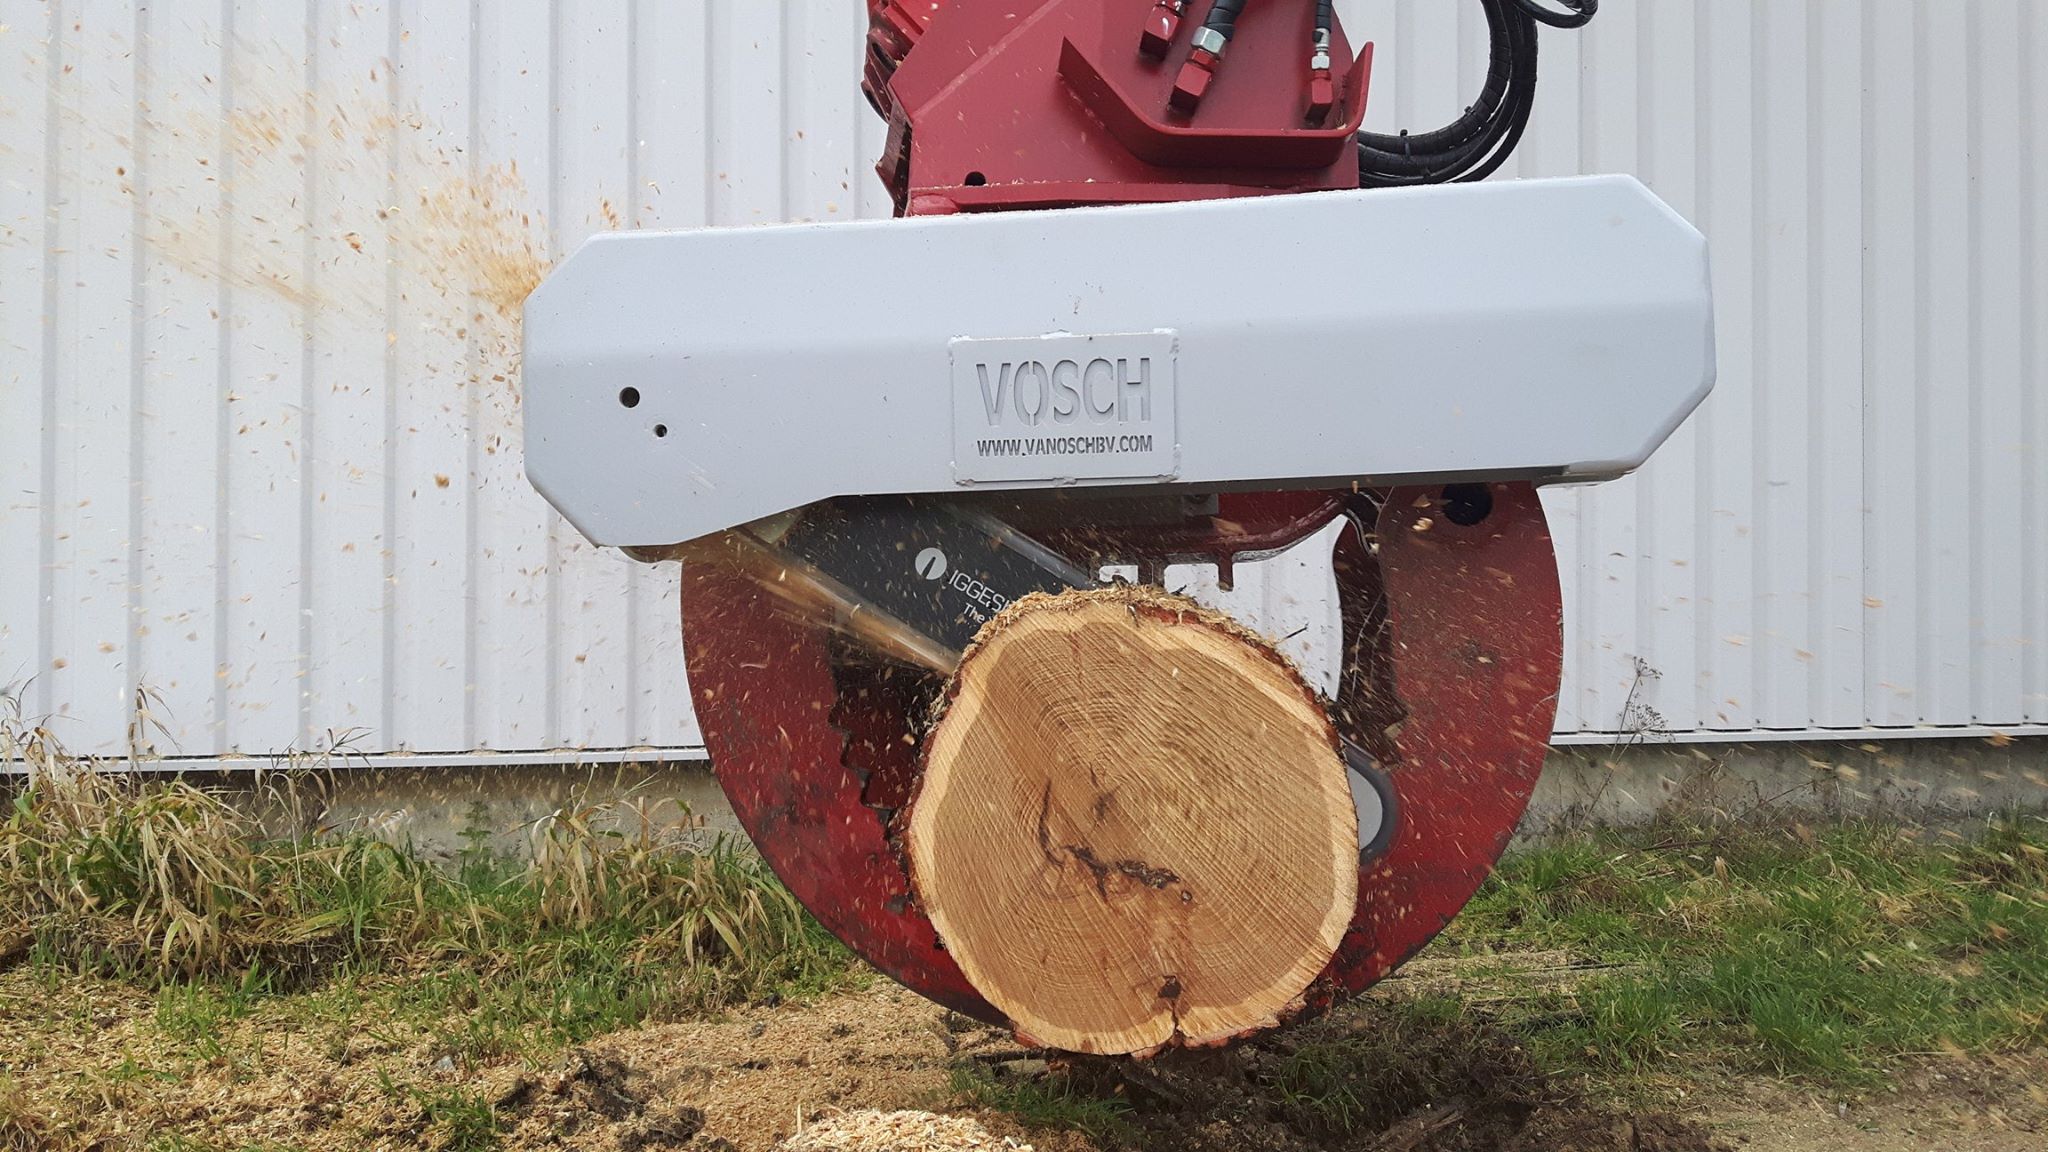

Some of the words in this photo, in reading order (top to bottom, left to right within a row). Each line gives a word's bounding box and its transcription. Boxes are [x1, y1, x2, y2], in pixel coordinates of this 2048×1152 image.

[976, 357, 1151, 426] VOSCH
[977, 435, 1152, 456] WWW.VANOSCHBV.COM
[963, 602, 986, 624] The
